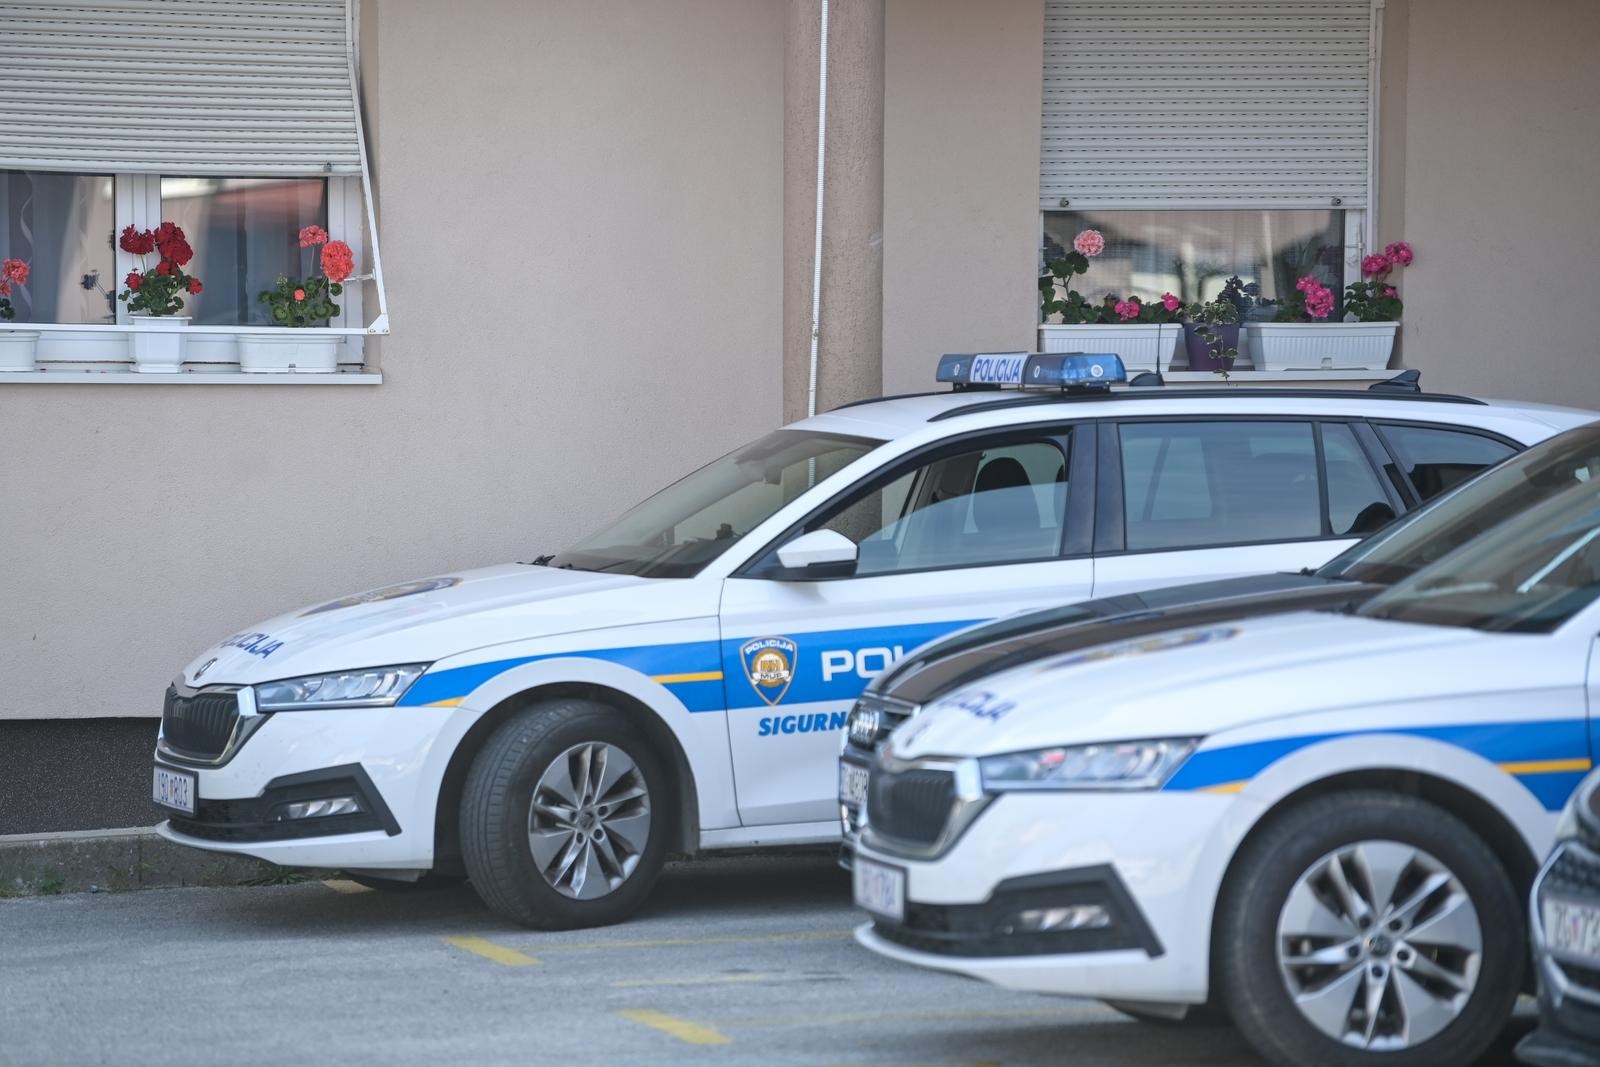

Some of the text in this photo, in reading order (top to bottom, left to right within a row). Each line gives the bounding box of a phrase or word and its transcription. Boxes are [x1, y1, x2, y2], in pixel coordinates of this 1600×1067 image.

[973, 358, 1022, 382] POLICIJA
[745, 640, 793, 654] POLICIJA
[758, 711, 847, 737] SIGURN
